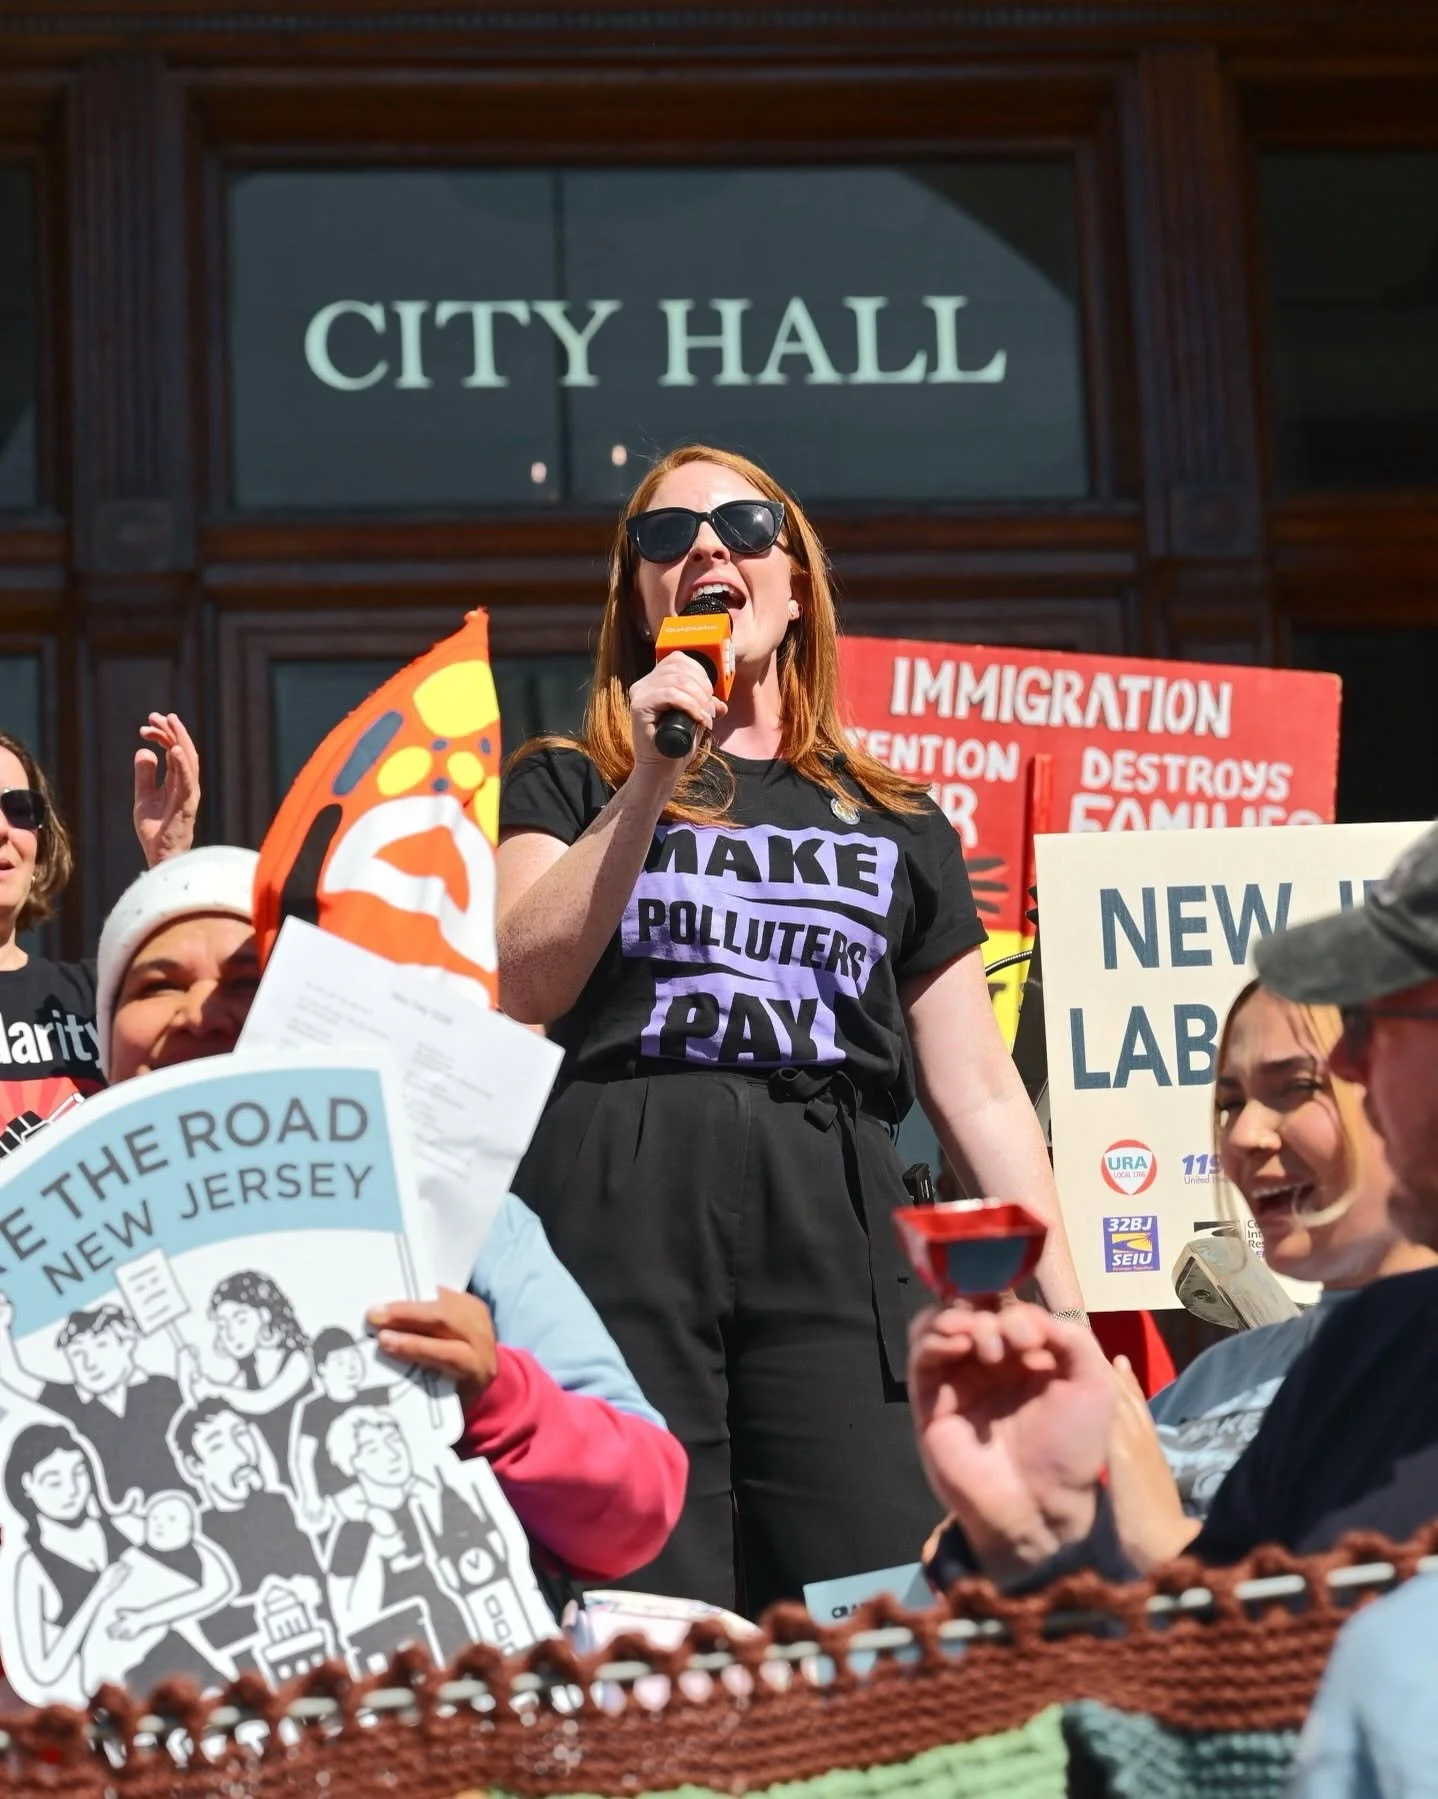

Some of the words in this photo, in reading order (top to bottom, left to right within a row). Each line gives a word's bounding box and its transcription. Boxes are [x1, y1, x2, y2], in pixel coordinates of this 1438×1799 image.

[304, 299, 622, 390] CITY
[658, 296, 1006, 385] HALL
[890, 656, 1233, 739] IMMIGRATION
[1080, 746, 1294, 802] DESTROYS
[643, 829, 879, 897] MAKE
[637, 897, 867, 981] POLLUTERS
[1099, 882, 1293, 970] NEW
[659, 991, 819, 1063] PAY
[40, 1124, 169, 1219] THE
[178, 1097, 369, 1159] ROAD
[1108, 1155, 1148, 1171] URA
[1113, 1171, 1131, 1179] LOCAL
[1184, 1174, 1210, 1185] United
[42, 1200, 153, 1296] NEW
[180, 1163, 374, 1220] JERSEY
[1108, 1217, 1152, 1232] 32BJ
[1111, 1252, 1153, 1267] SEIU
